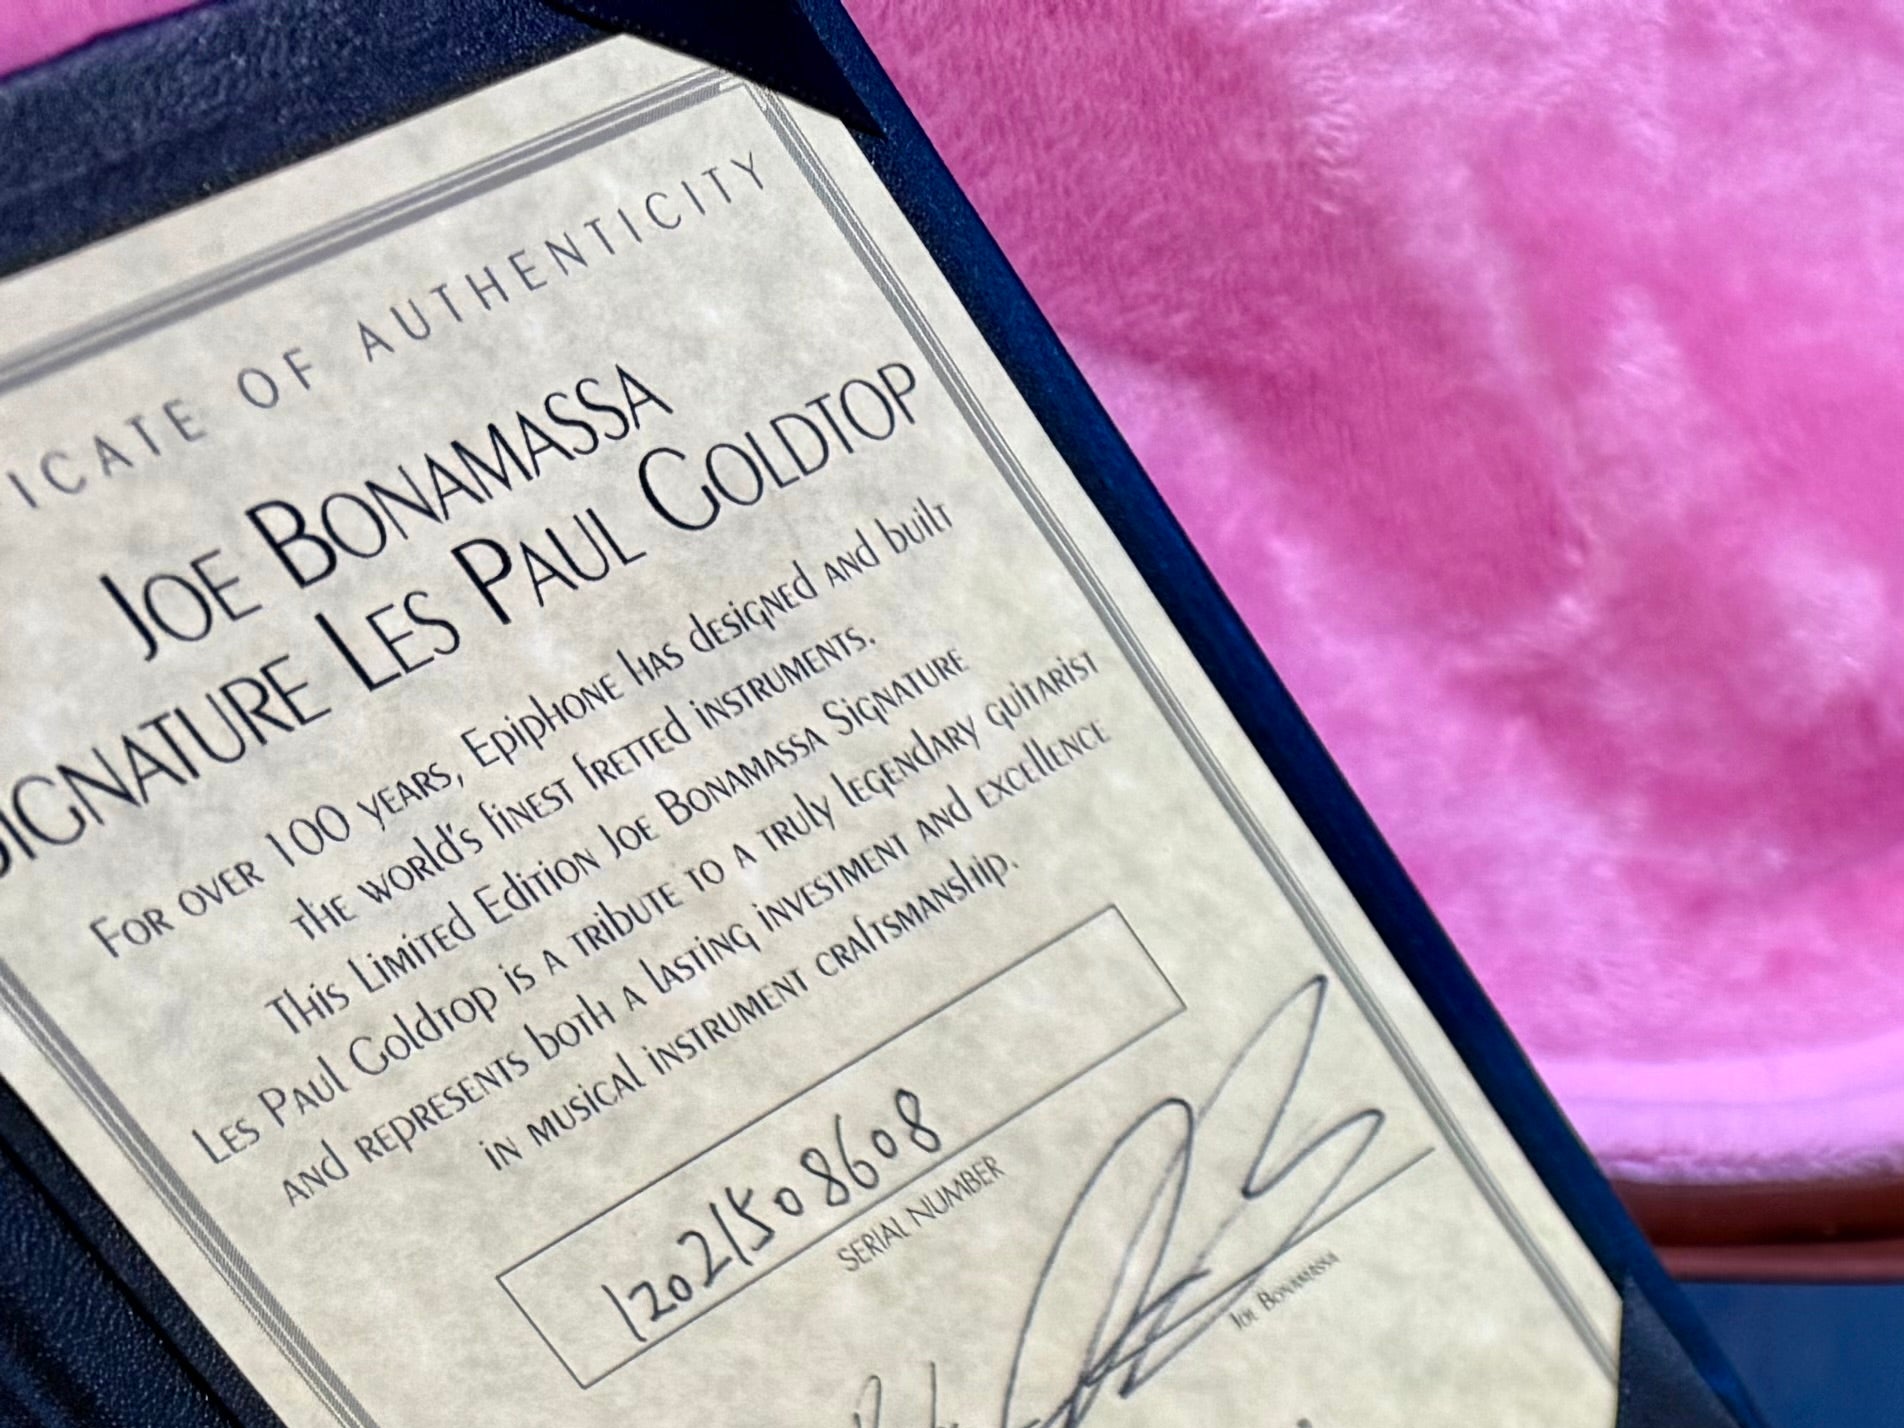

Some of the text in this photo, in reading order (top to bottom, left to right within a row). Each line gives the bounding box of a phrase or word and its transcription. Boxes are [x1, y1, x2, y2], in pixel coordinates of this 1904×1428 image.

[235, 346, 314, 411] OF
[356, 149, 765, 364] AUTHENTICITY
[97, 362, 675, 664] JOE BONAMASSA
[313, 589, 462, 694] LES
[449, 506, 648, 627] PAUL
[636, 361, 917, 533] GOLDTOP
[263, 803, 352, 869] 100
[835, 1154, 1007, 1274] SERIAL NUMBER
